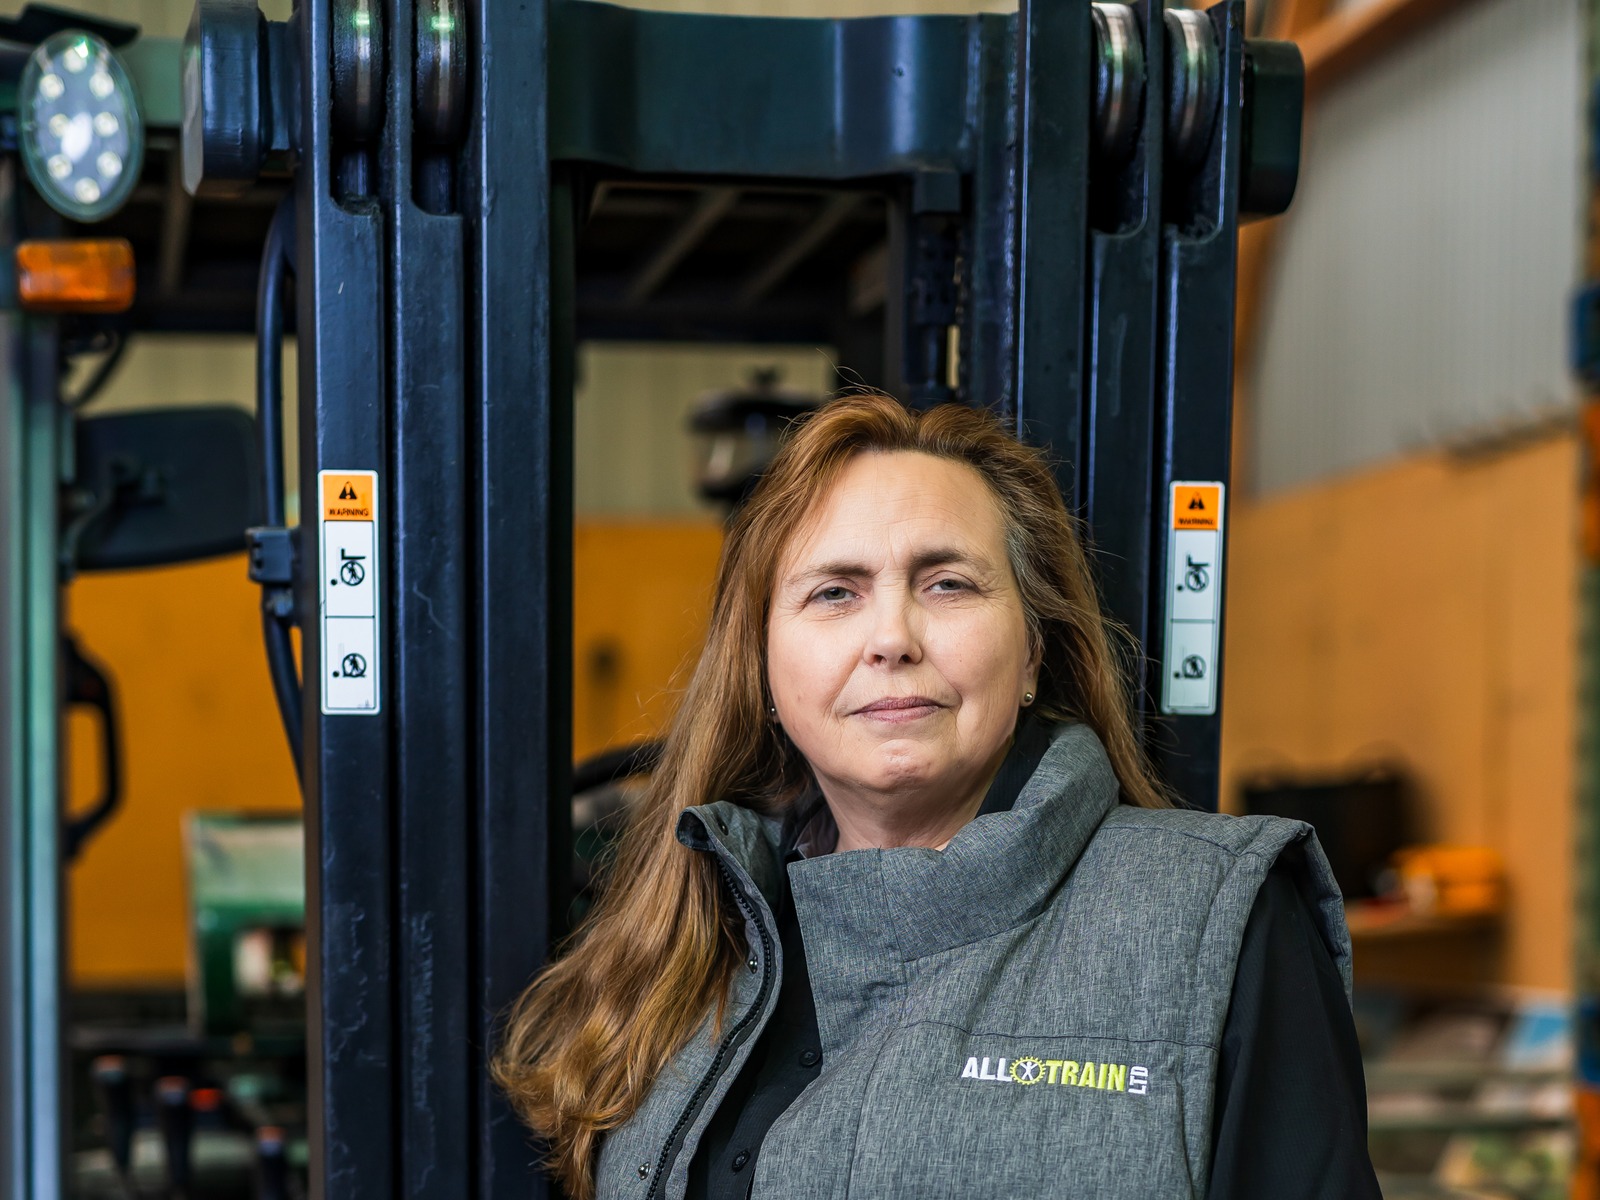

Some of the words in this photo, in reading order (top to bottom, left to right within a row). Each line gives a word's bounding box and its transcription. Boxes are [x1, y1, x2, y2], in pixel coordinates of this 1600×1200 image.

[328, 508, 370, 517] WARNING
[961, 1056, 1014, 1083] ALL
[1045, 1059, 1128, 1092] TRAIN
[1128, 1064, 1150, 1095] LTD
